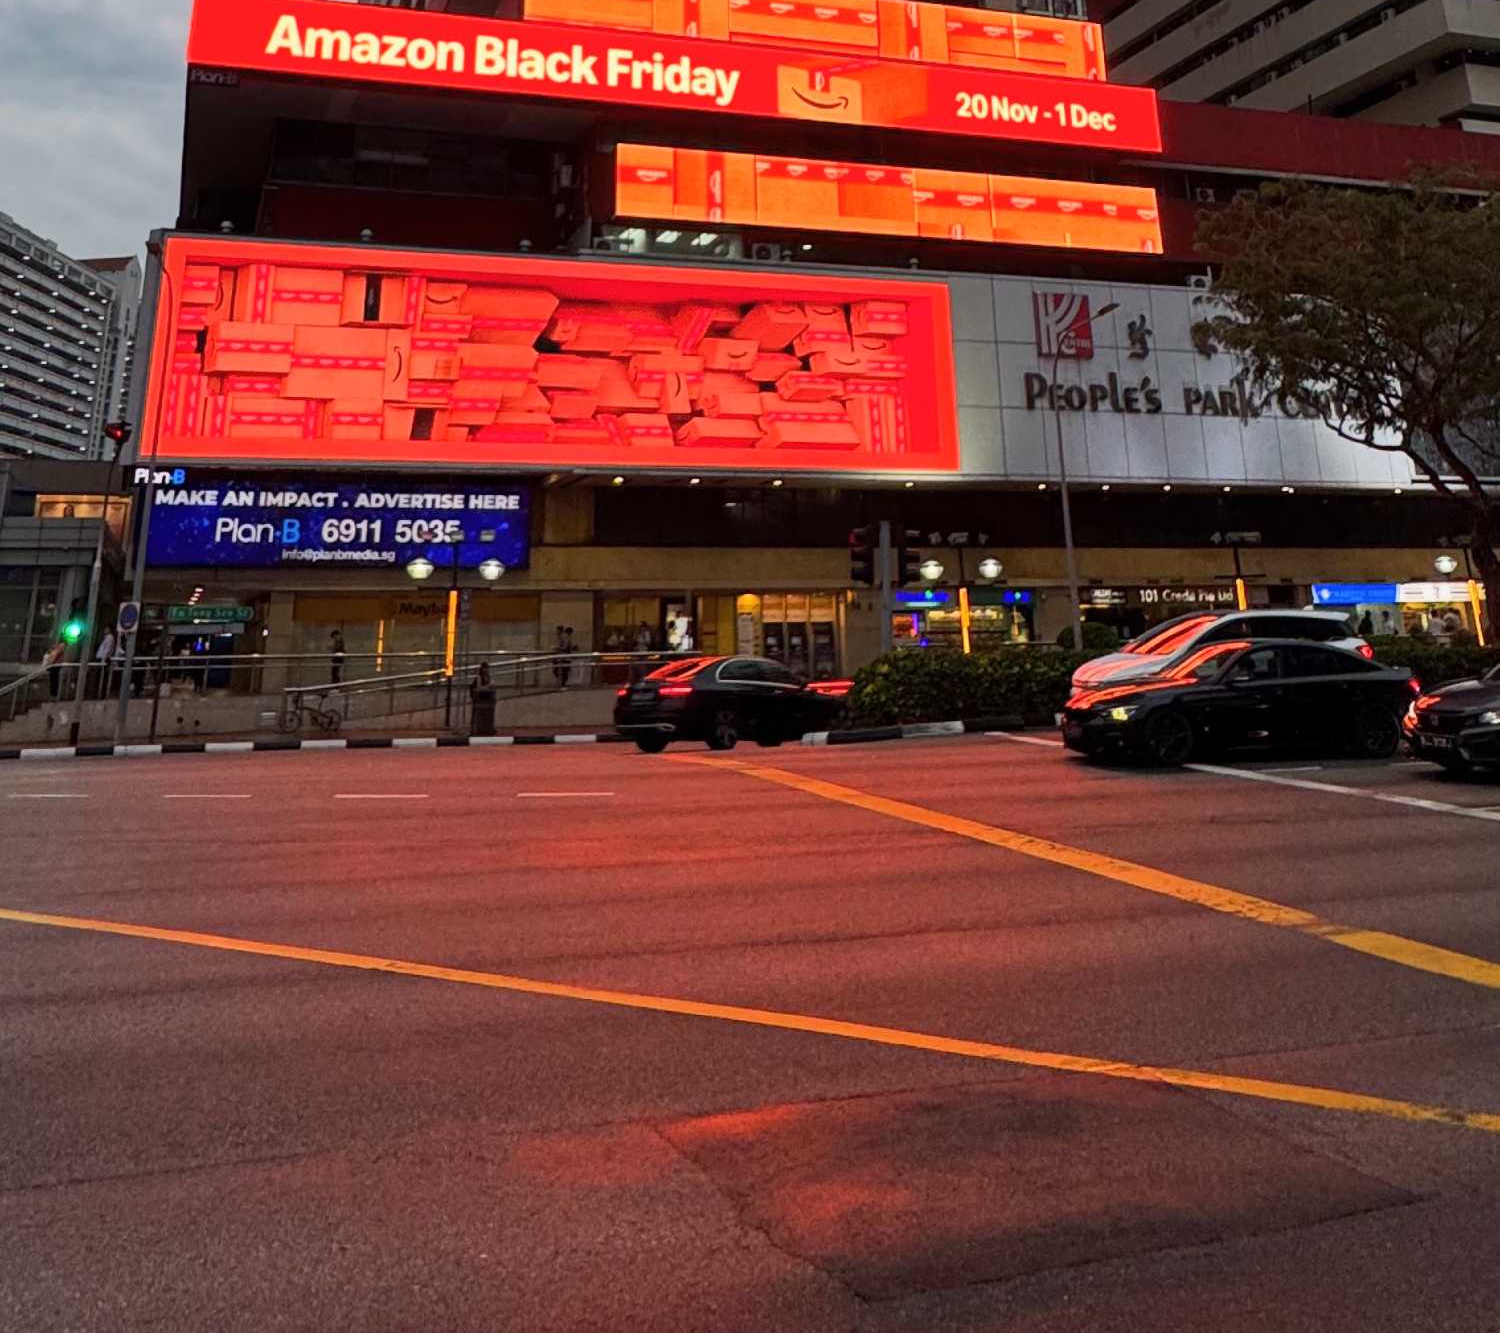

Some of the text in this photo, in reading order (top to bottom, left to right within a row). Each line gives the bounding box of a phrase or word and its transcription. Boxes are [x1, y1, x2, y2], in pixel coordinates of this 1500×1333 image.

[264, 13, 740, 106] Amazon Black Friday
[955, 91, 988, 119] 20
[991, 95, 1038, 124] Nov
[1070, 103, 1117, 132] Dec
[155, 490, 219, 506] MAKE
[222, 491, 255, 507] AN
[260, 491, 339, 508] IMPACT
[354, 493, 465, 510] ADVERTISE
[469, 494, 521, 510] HERE
[321, 519, 382, 543] 6911
[1139, 589, 1158, 602] 101
